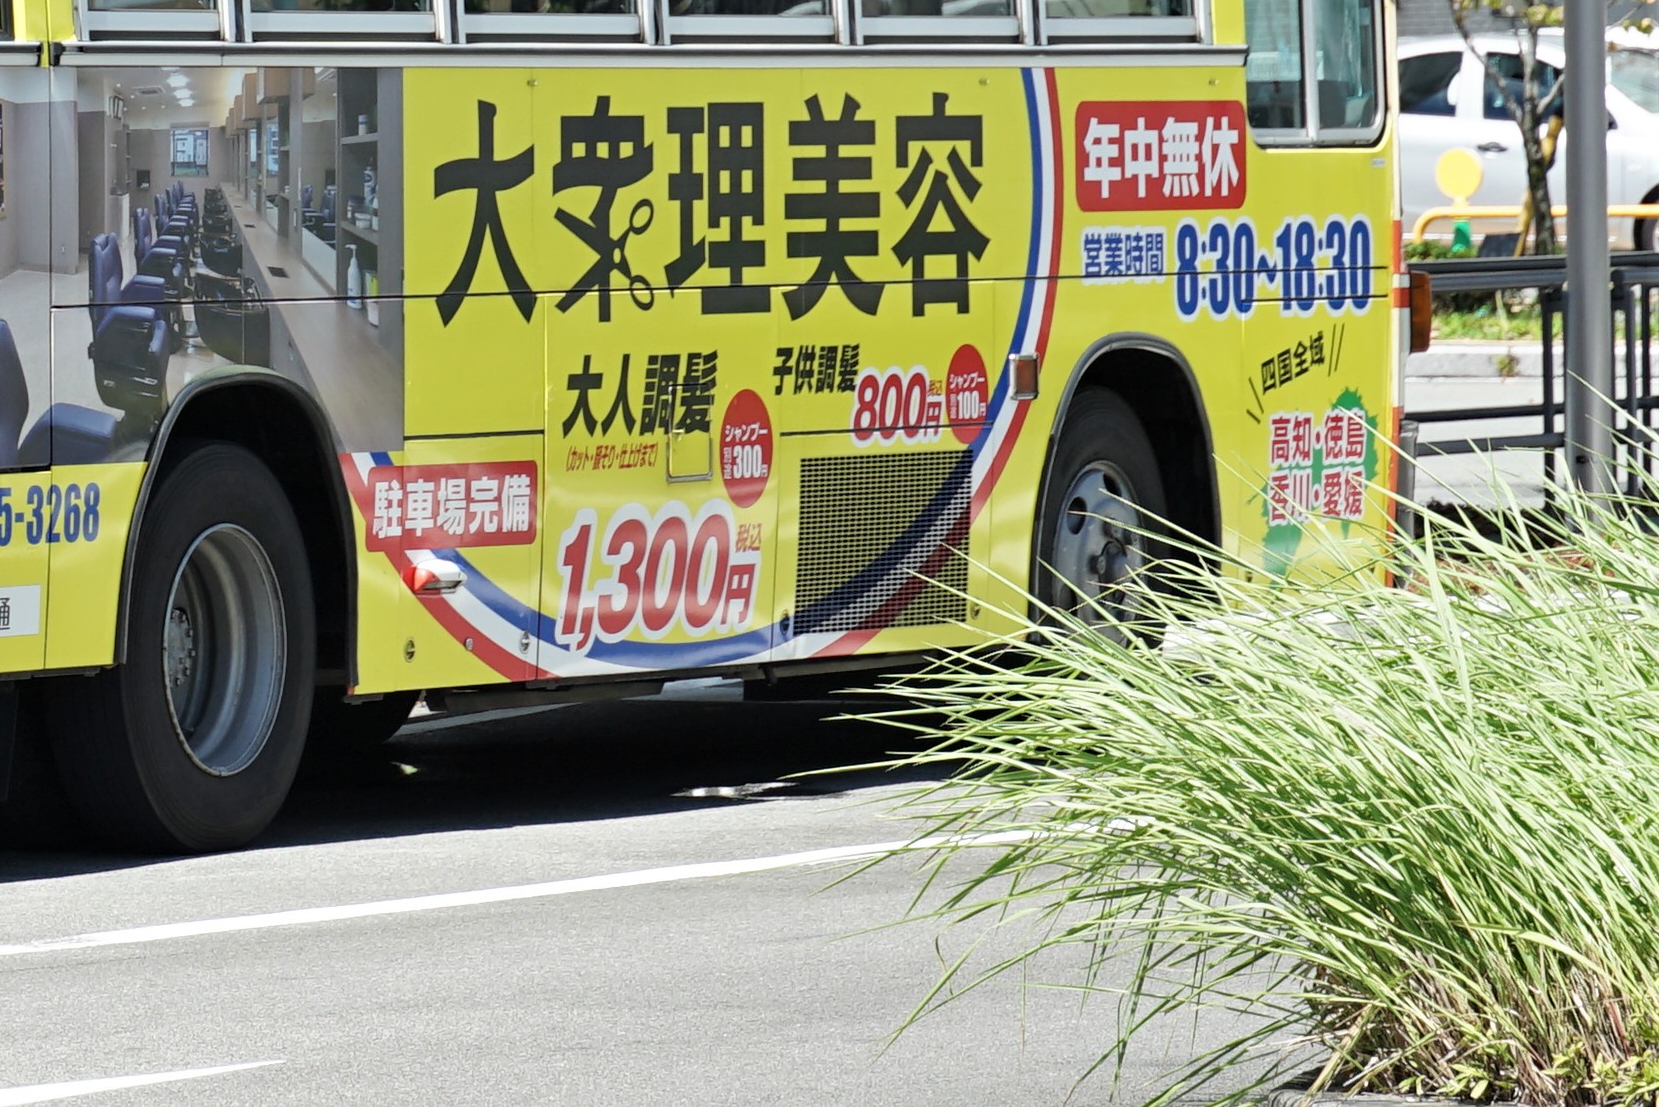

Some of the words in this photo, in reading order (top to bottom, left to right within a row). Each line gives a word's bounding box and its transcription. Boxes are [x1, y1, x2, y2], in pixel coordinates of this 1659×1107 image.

[1083, 117, 1239, 198] 年中無休
[434, 92, 991, 328] 大衆理美容
[1084, 232, 1164, 278] 営業時間
[772, 344, 860, 396] 子供調髪
[1260, 331, 1325, 394] 四国全域
[562, 350, 717, 438] 大人調髪
[853, 372, 942, 442] 800円
[957, 390, 987, 419] 100円
[733, 445, 769, 479] 300円
[1270, 412, 1365, 464] 高知・徳島
[373, 472, 531, 538] 駐車場完備
[1269, 471, 1364, 522] 香川・愛媛
[735, 523, 763, 552] 税込
[560, 514, 757, 652] 1,300円
